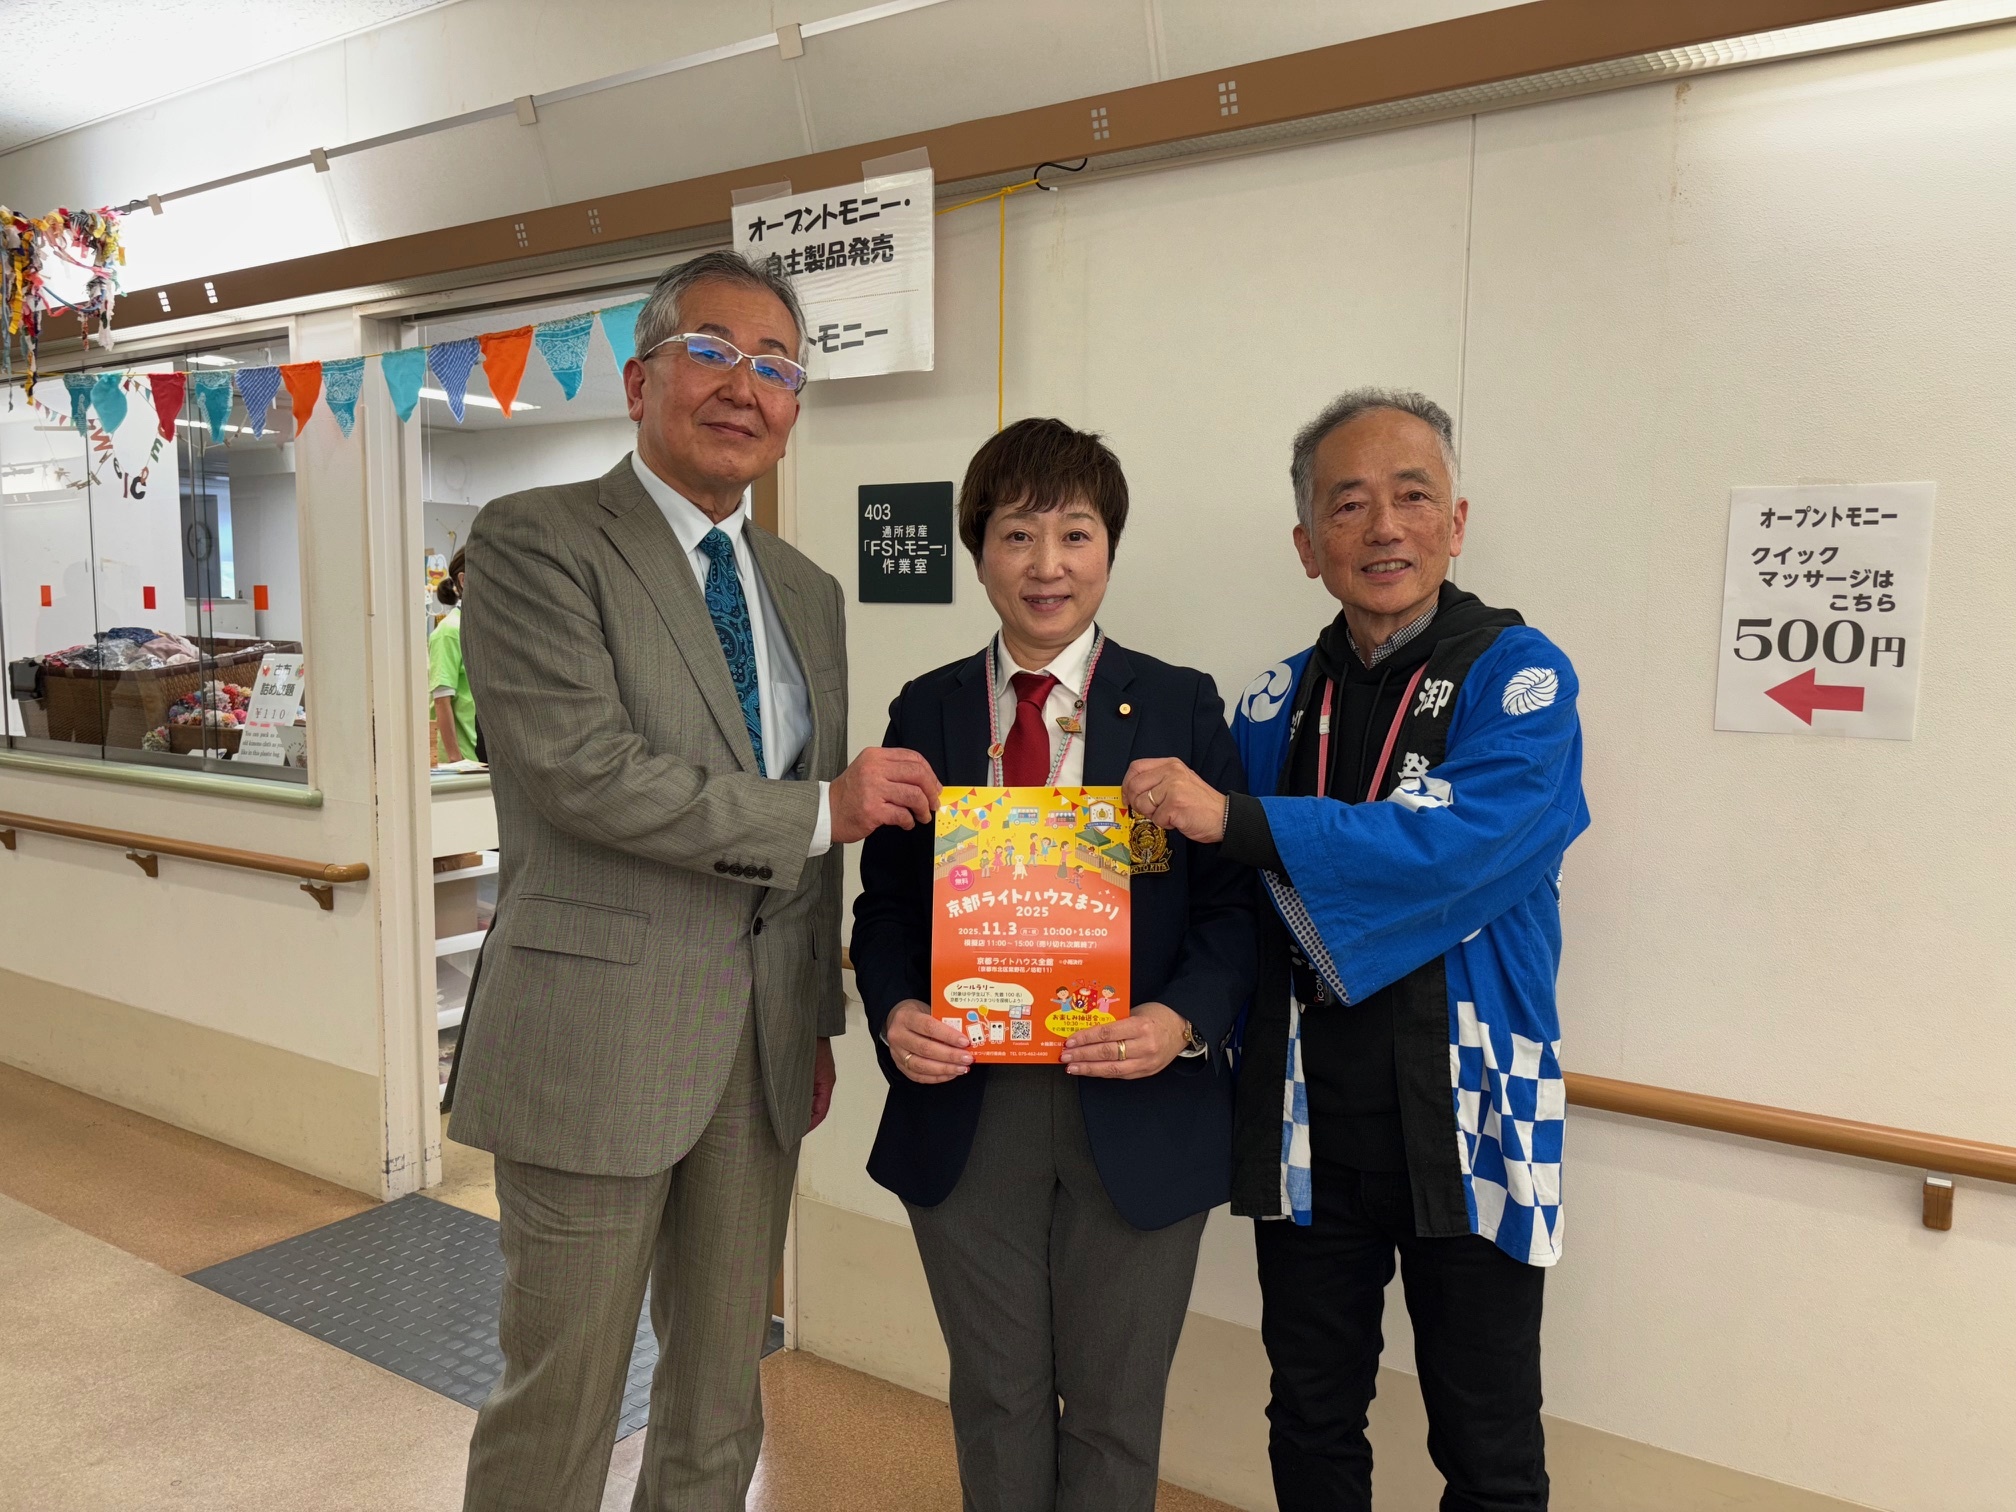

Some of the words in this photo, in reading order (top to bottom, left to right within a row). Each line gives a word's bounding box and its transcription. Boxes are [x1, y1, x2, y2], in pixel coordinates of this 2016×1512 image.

[766, 234, 894, 278] 自主製品発売
[864, 503, 891, 521] 403
[1760, 505, 1898, 529] オープントモニー
[881, 524, 928, 538] 通所授産
[864, 540, 947, 557] 「FSトモニー」
[1751, 546, 1839, 565] クイック
[882, 558, 928, 575] 作業室
[1758, 568, 1895, 589] マッサージは
[1829, 593, 1896, 612] こちら
[1733, 617, 1906, 668] 500円
[954, 870, 968, 878] 入場
[954, 877, 969, 886] 無料
[946, 888, 1120, 920] 京都ライトハウスまつり
[1016, 906, 1049, 917] 2025
